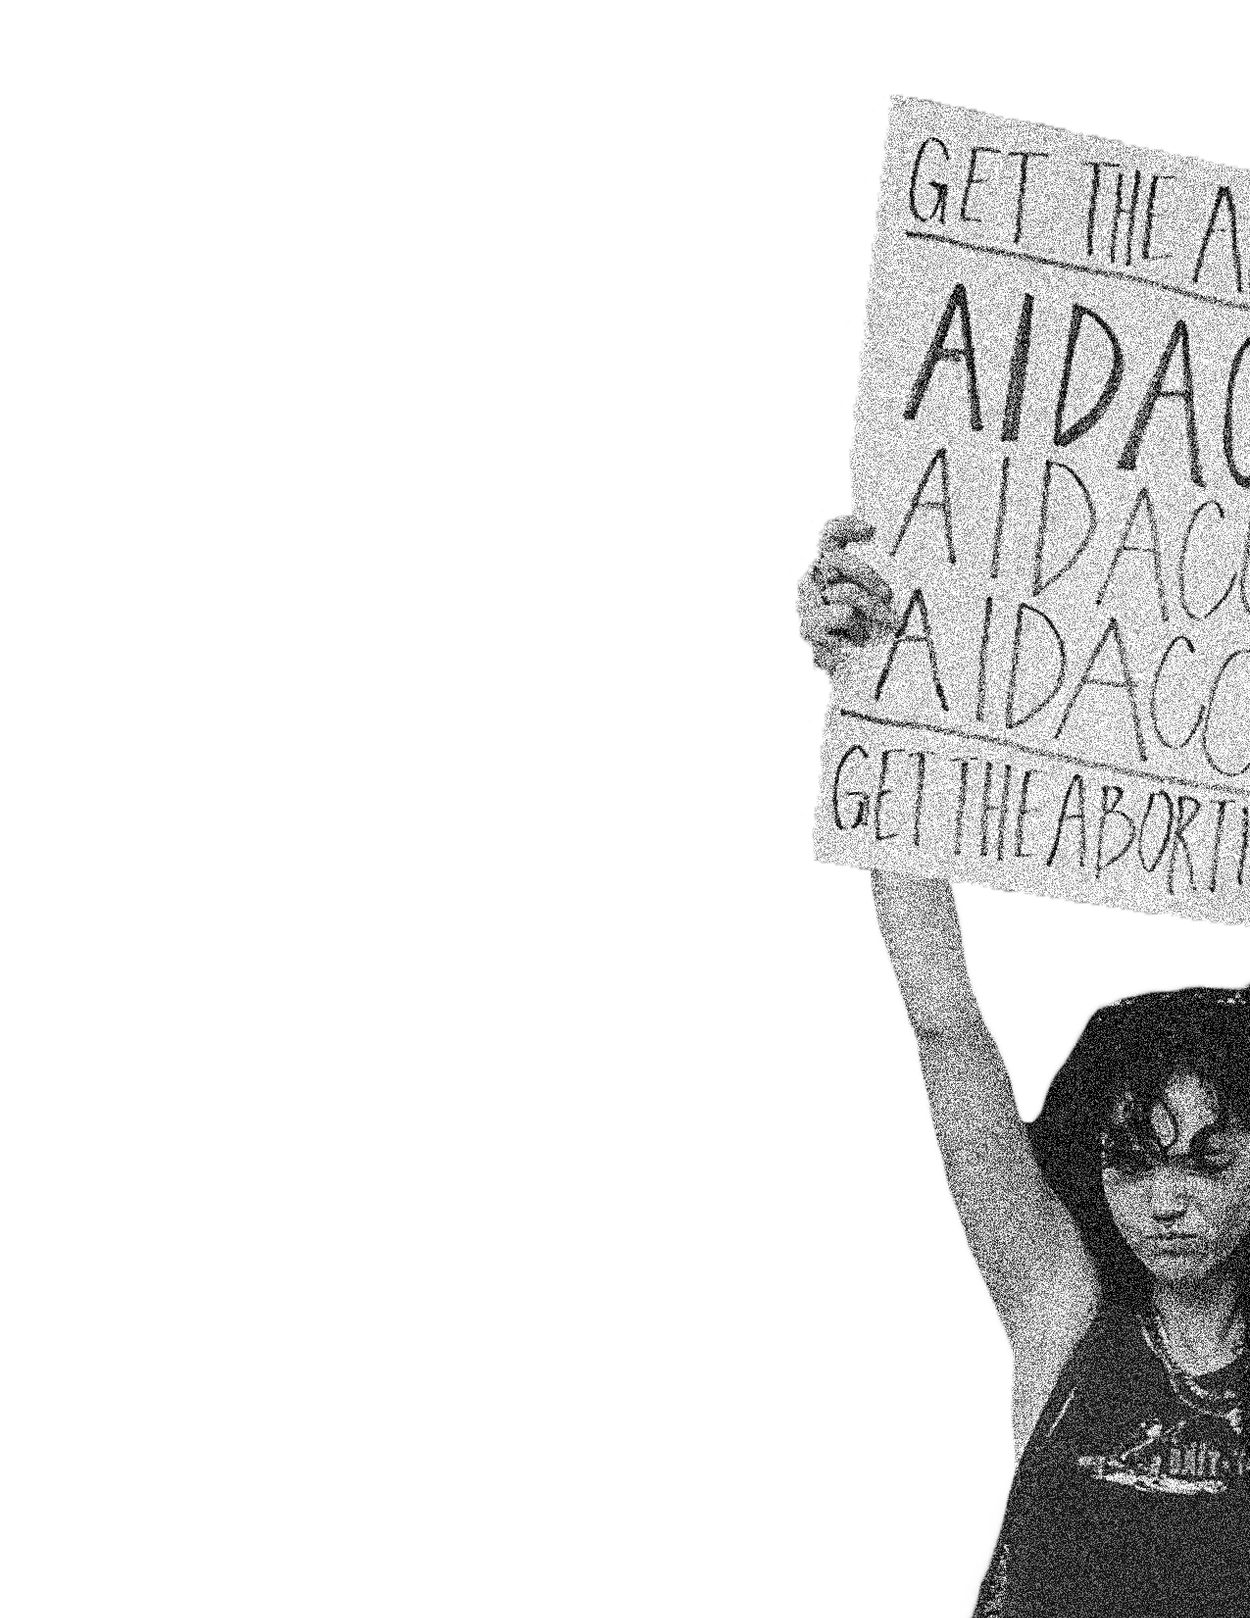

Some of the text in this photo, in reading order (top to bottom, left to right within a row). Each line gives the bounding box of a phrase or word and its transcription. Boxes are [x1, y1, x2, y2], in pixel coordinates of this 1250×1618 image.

[909, 137, 1049, 246] GET
[1085, 161, 1175, 266] THE
[832, 745, 937, 847] GET
[946, 752, 1037, 861] THE
